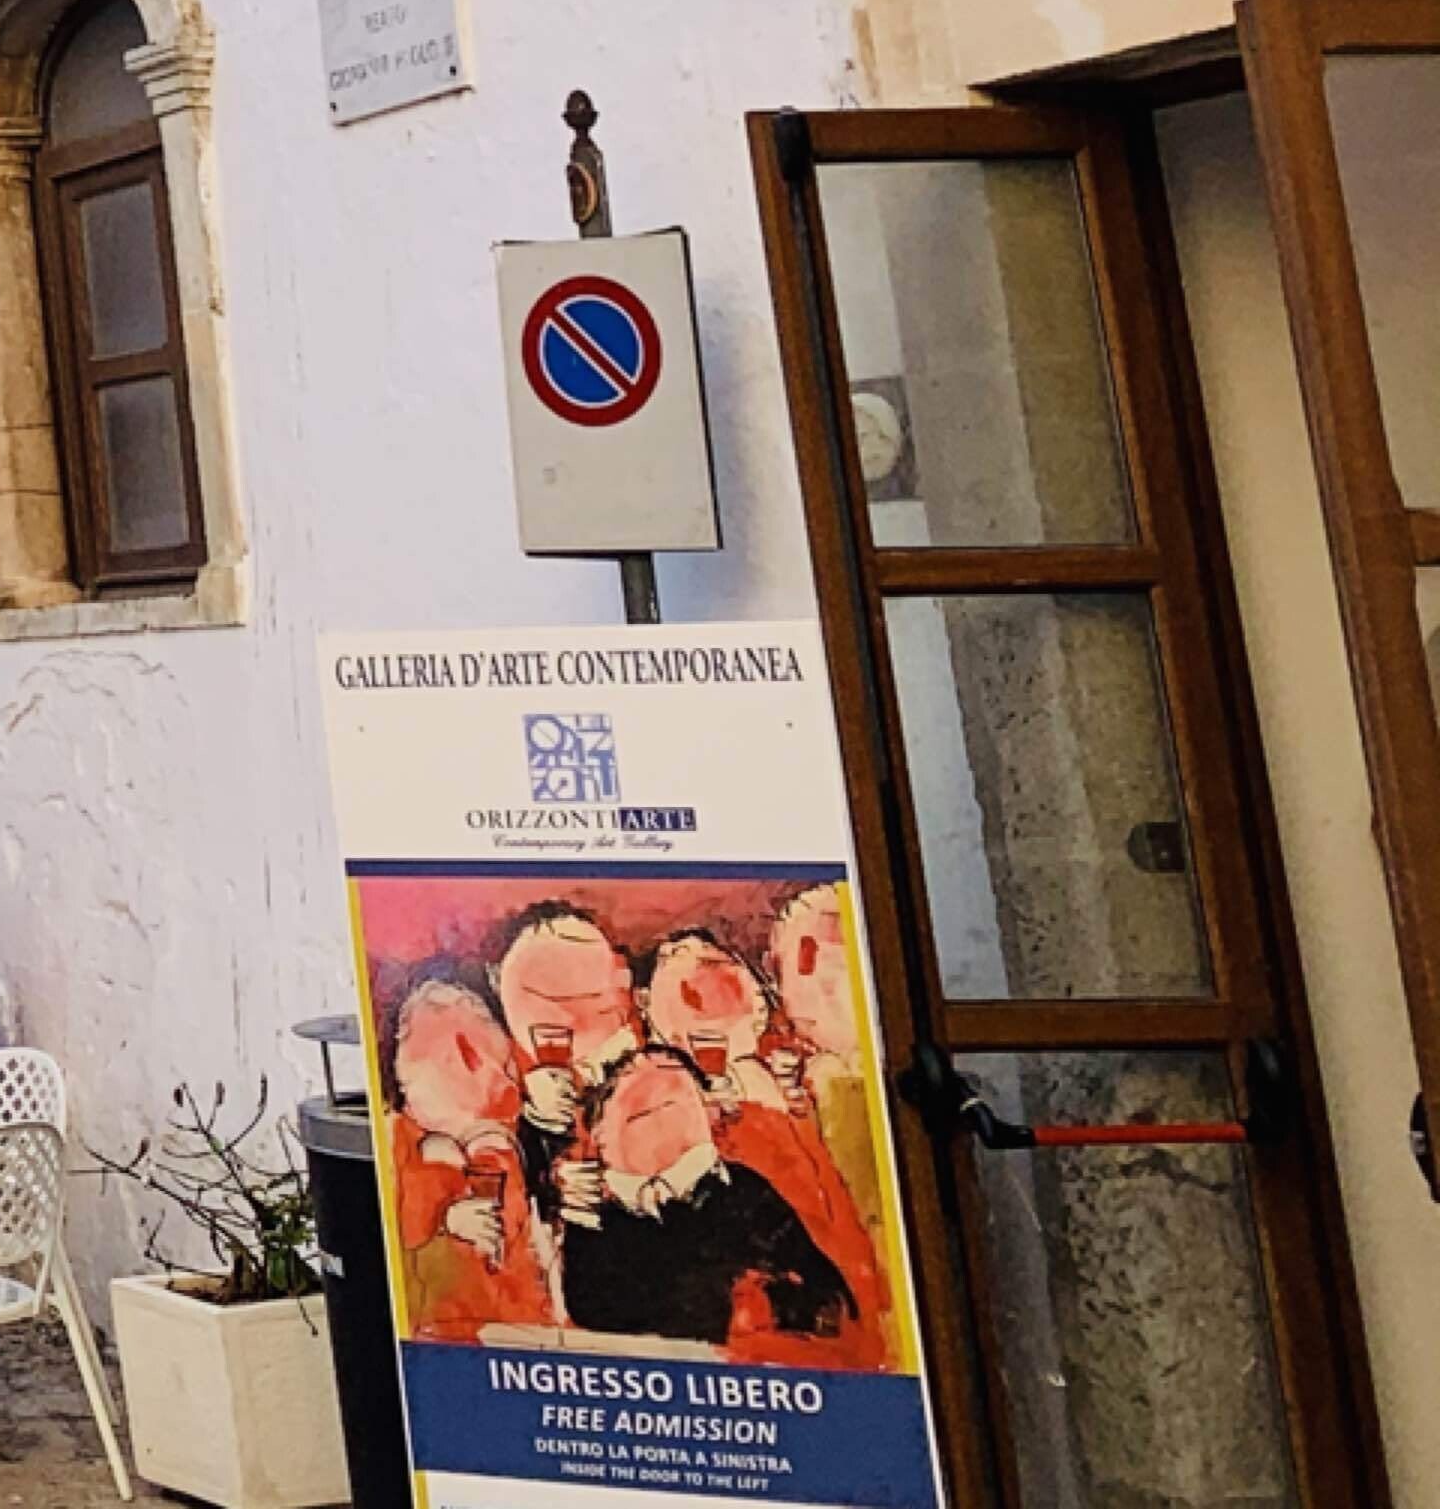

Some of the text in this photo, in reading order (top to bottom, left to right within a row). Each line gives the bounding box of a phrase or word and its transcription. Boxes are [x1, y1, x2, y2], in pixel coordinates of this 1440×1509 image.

[335, 646, 805, 689] GALLERIA D'ARTE CONTEMPORANEA
[487, 1358, 824, 1415] INGRESSO LIBERO
[541, 1403, 778, 1447] FREE ADMISSION
[534, 1436, 793, 1475] DENTRO LA PORTA A SINISTRA
[560, 1460, 770, 1493] INSIDE THE DOOR TO THE LEFT
